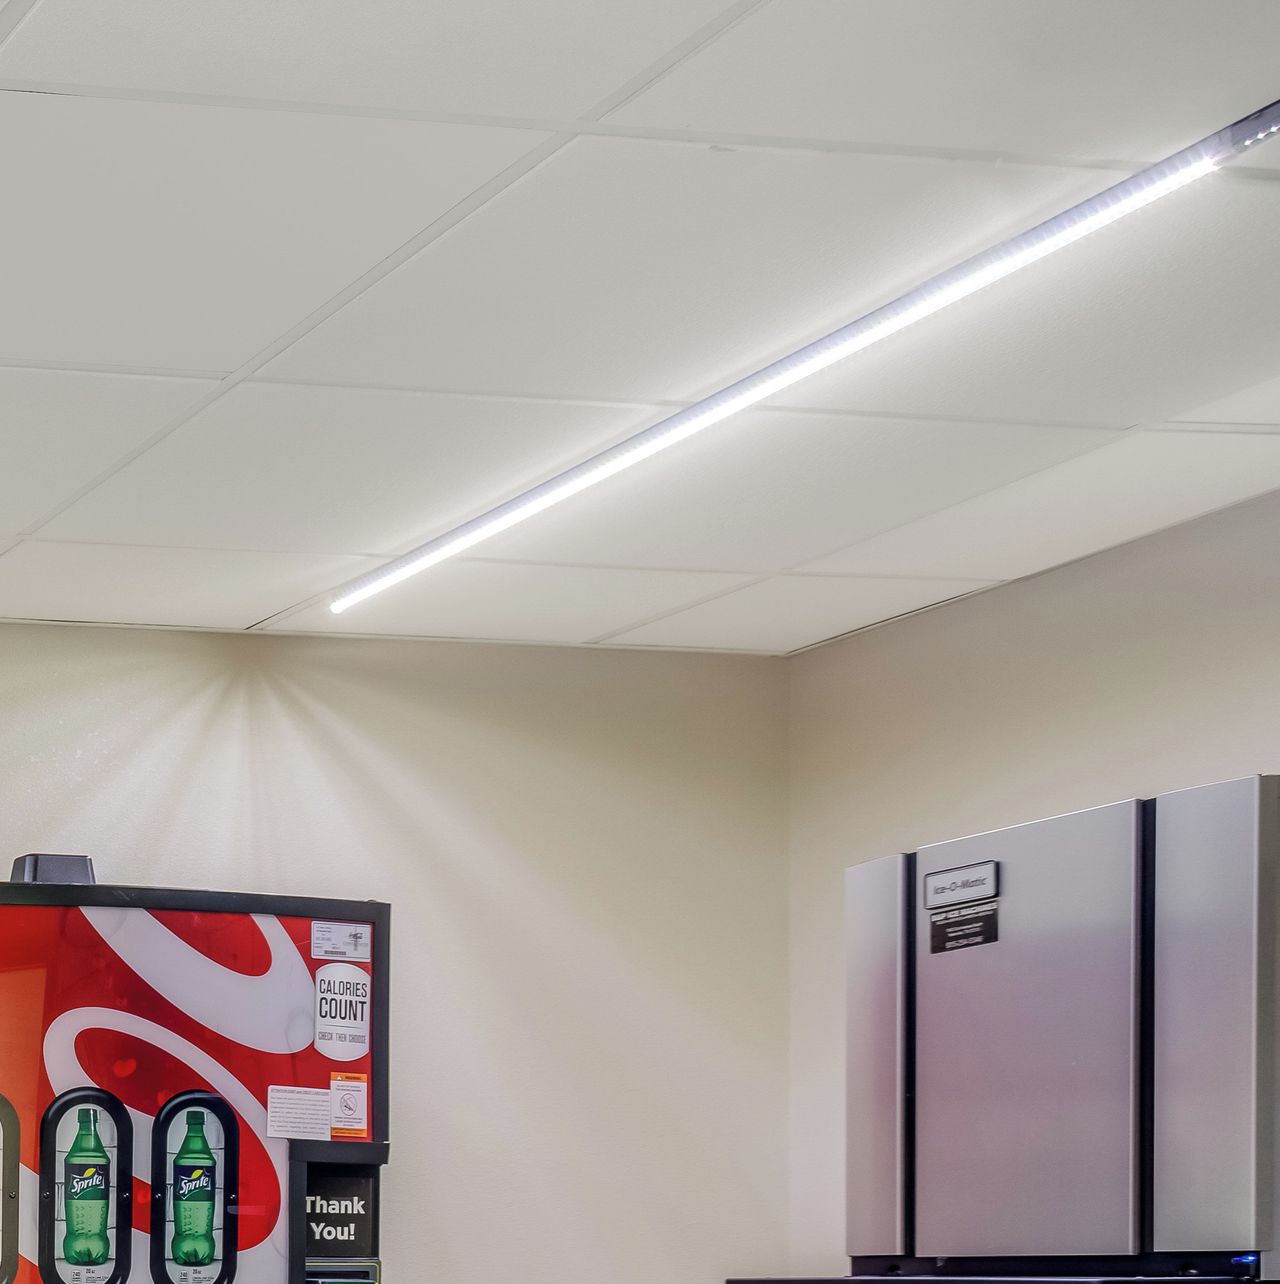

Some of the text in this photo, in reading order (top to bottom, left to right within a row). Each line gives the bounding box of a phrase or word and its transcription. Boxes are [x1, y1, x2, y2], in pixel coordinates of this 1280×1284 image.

[933, 875, 989, 895] Ice-O-Matic
[318, 978, 368, 998] CALORIES
[318, 996, 368, 1022] COUNT
[318, 1031, 367, 1044] CHECK THEN CHOOSE
[71, 1173, 103, 1194] Sprite
[179, 1175, 210, 1194] Sprite
[304, 1195, 366, 1215] Thank
[309, 1221, 356, 1241] You!
